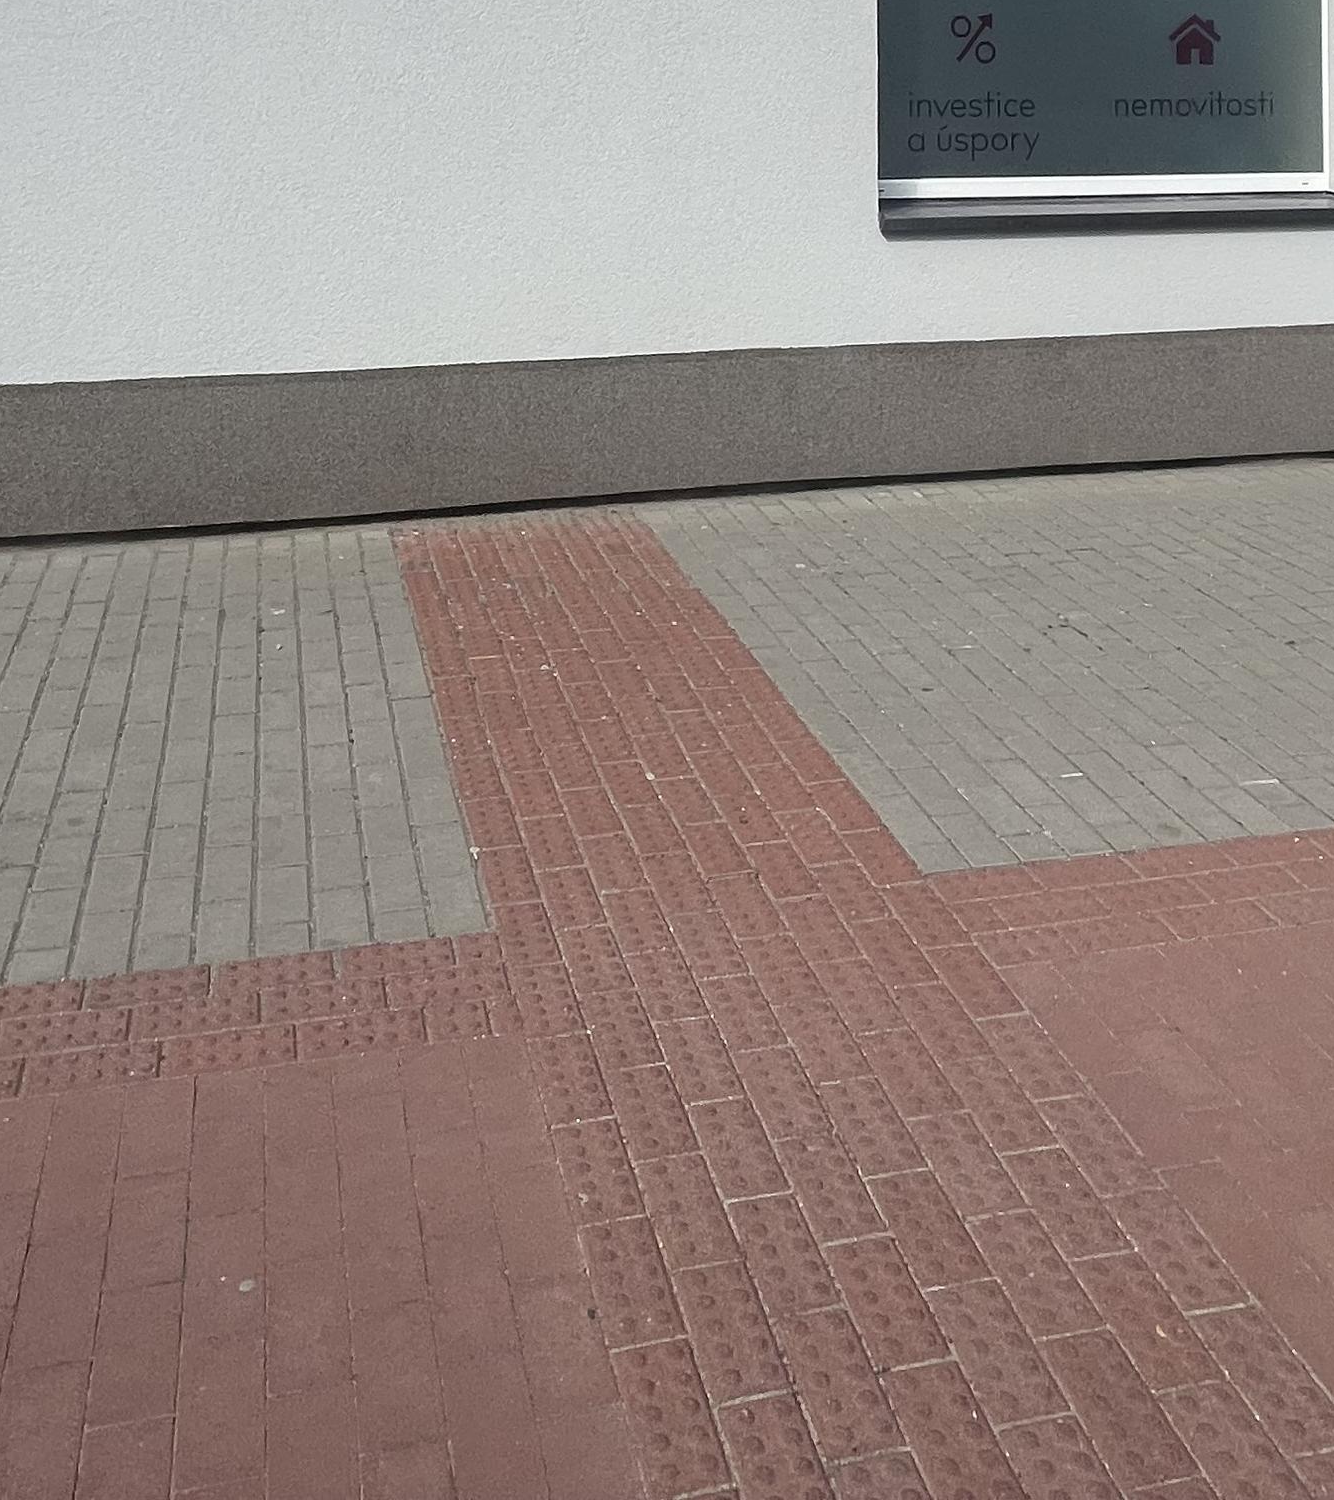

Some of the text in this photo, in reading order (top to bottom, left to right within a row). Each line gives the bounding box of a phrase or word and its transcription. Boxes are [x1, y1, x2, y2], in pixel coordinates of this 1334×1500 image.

[908, 91, 1036, 118] investice
[907, 124, 1040, 162] a úspory
